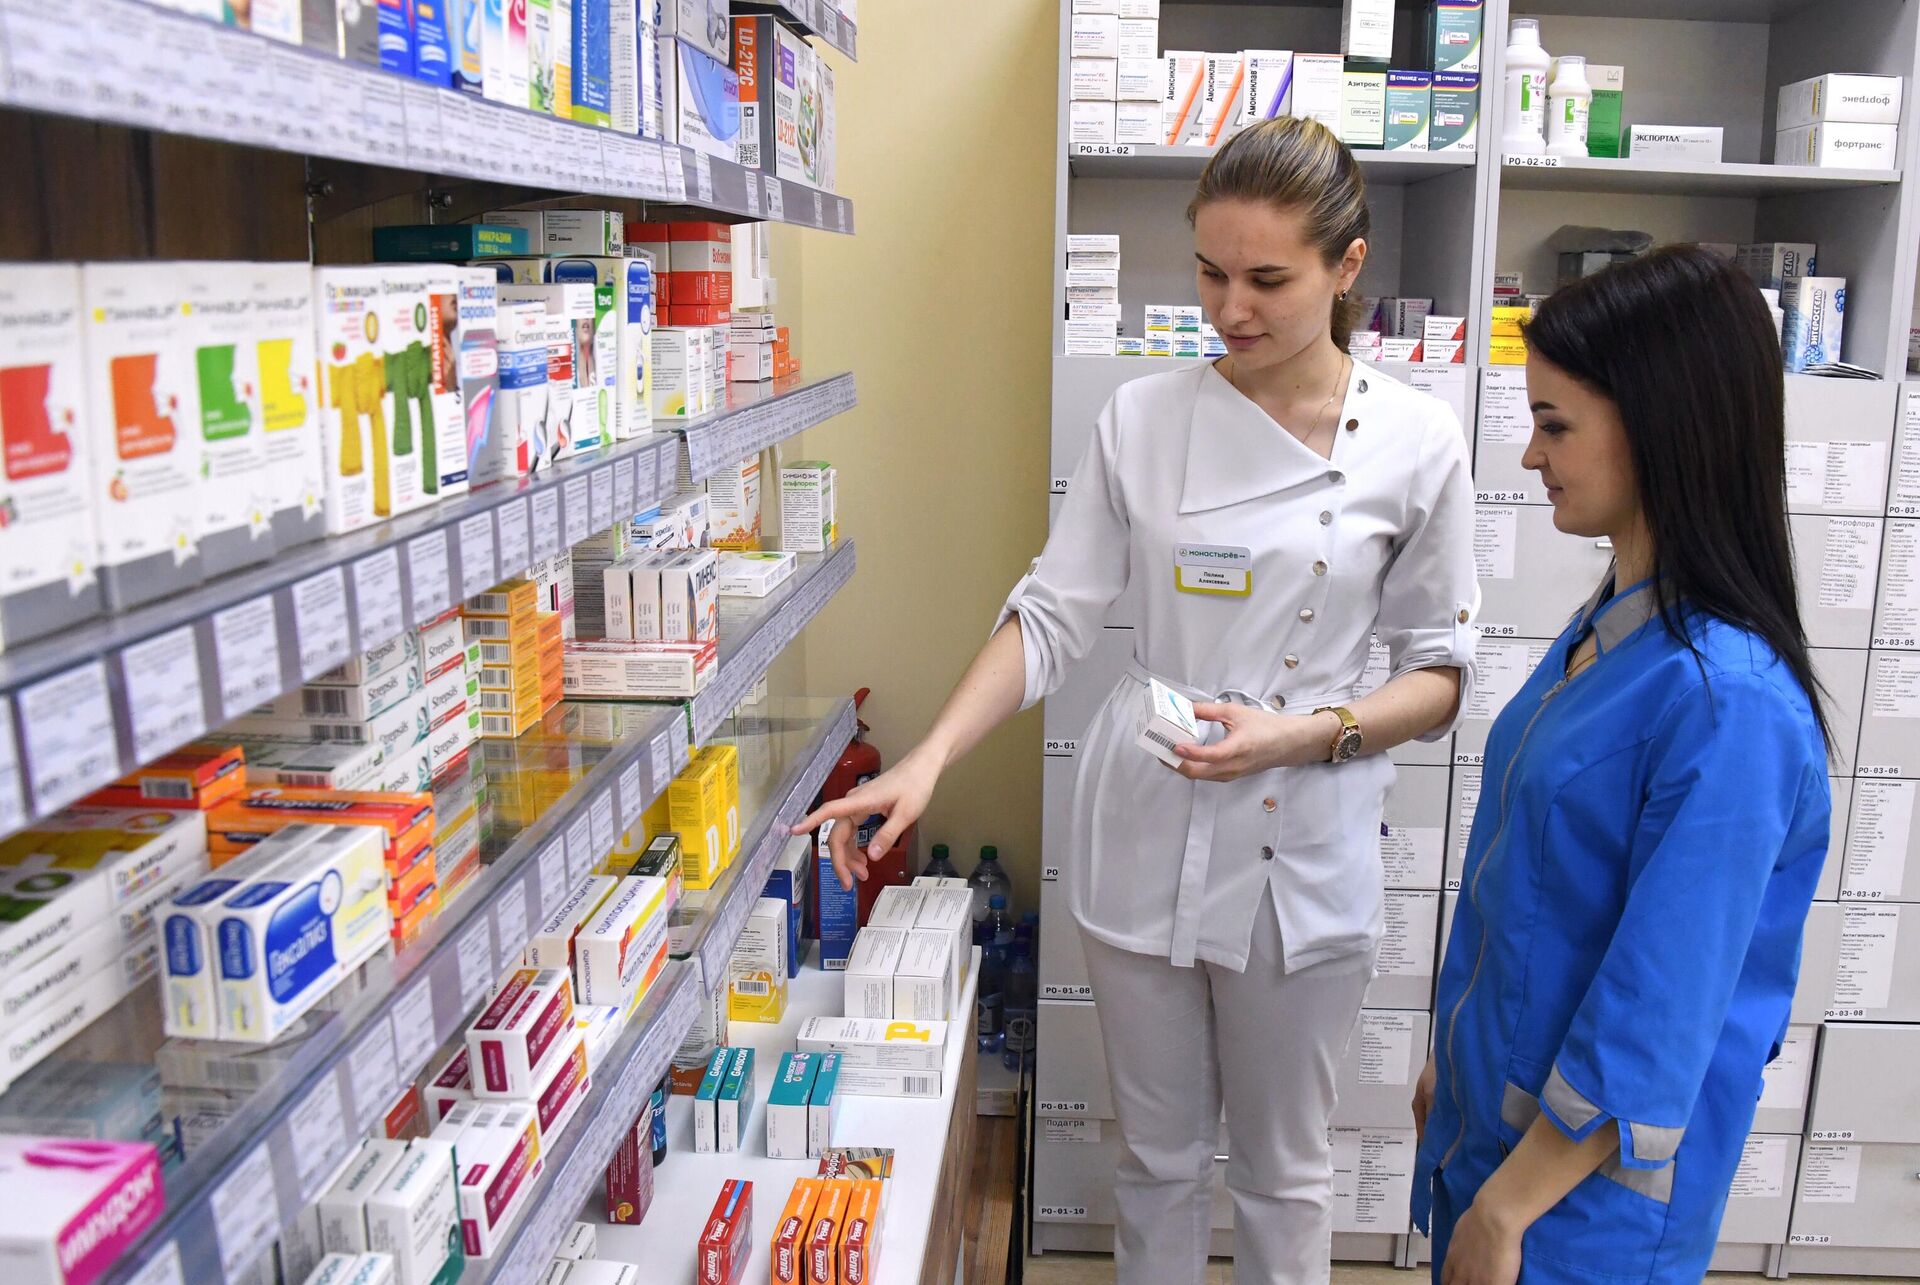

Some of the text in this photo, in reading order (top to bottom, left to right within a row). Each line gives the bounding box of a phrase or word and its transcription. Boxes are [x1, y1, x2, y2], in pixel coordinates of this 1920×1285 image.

[738, 27, 754, 87] LD-212C
[1166, 57, 1176, 101] Амоксиклав
[1205, 59, 1216, 102] Амоксиклав
[1247, 71, 1257, 116] Амоксиклав
[1347, 80, 1381, 89] Азитрокс
[1457, 142, 1474, 150] teva
[1634, 134, 1680, 143] ЭКСПОРТАЛ
[1834, 139, 1883, 150] фортранс
[1810, 289, 1823, 346] ЭНТЕРОСГЕЛЬ
[1204, 571, 1225, 579] Полина
[432, 684, 459, 710] Strepsils
[379, 720, 410, 745] Strepsils
[432, 732, 460, 759] Strepsils
[709, 1048, 728, 1077] GAVISCON
[731, 1048, 748, 1077] GAVISCON
[1046, 1119, 1085, 1129] Подагра
[60, 1165, 155, 1273] ИМУДОН
[706, 1249, 721, 1282] Rennie
[779, 1247, 791, 1281] Rennie
[814, 1249, 826, 1281] Rennie
[849, 1250, 860, 1284] Rennie
